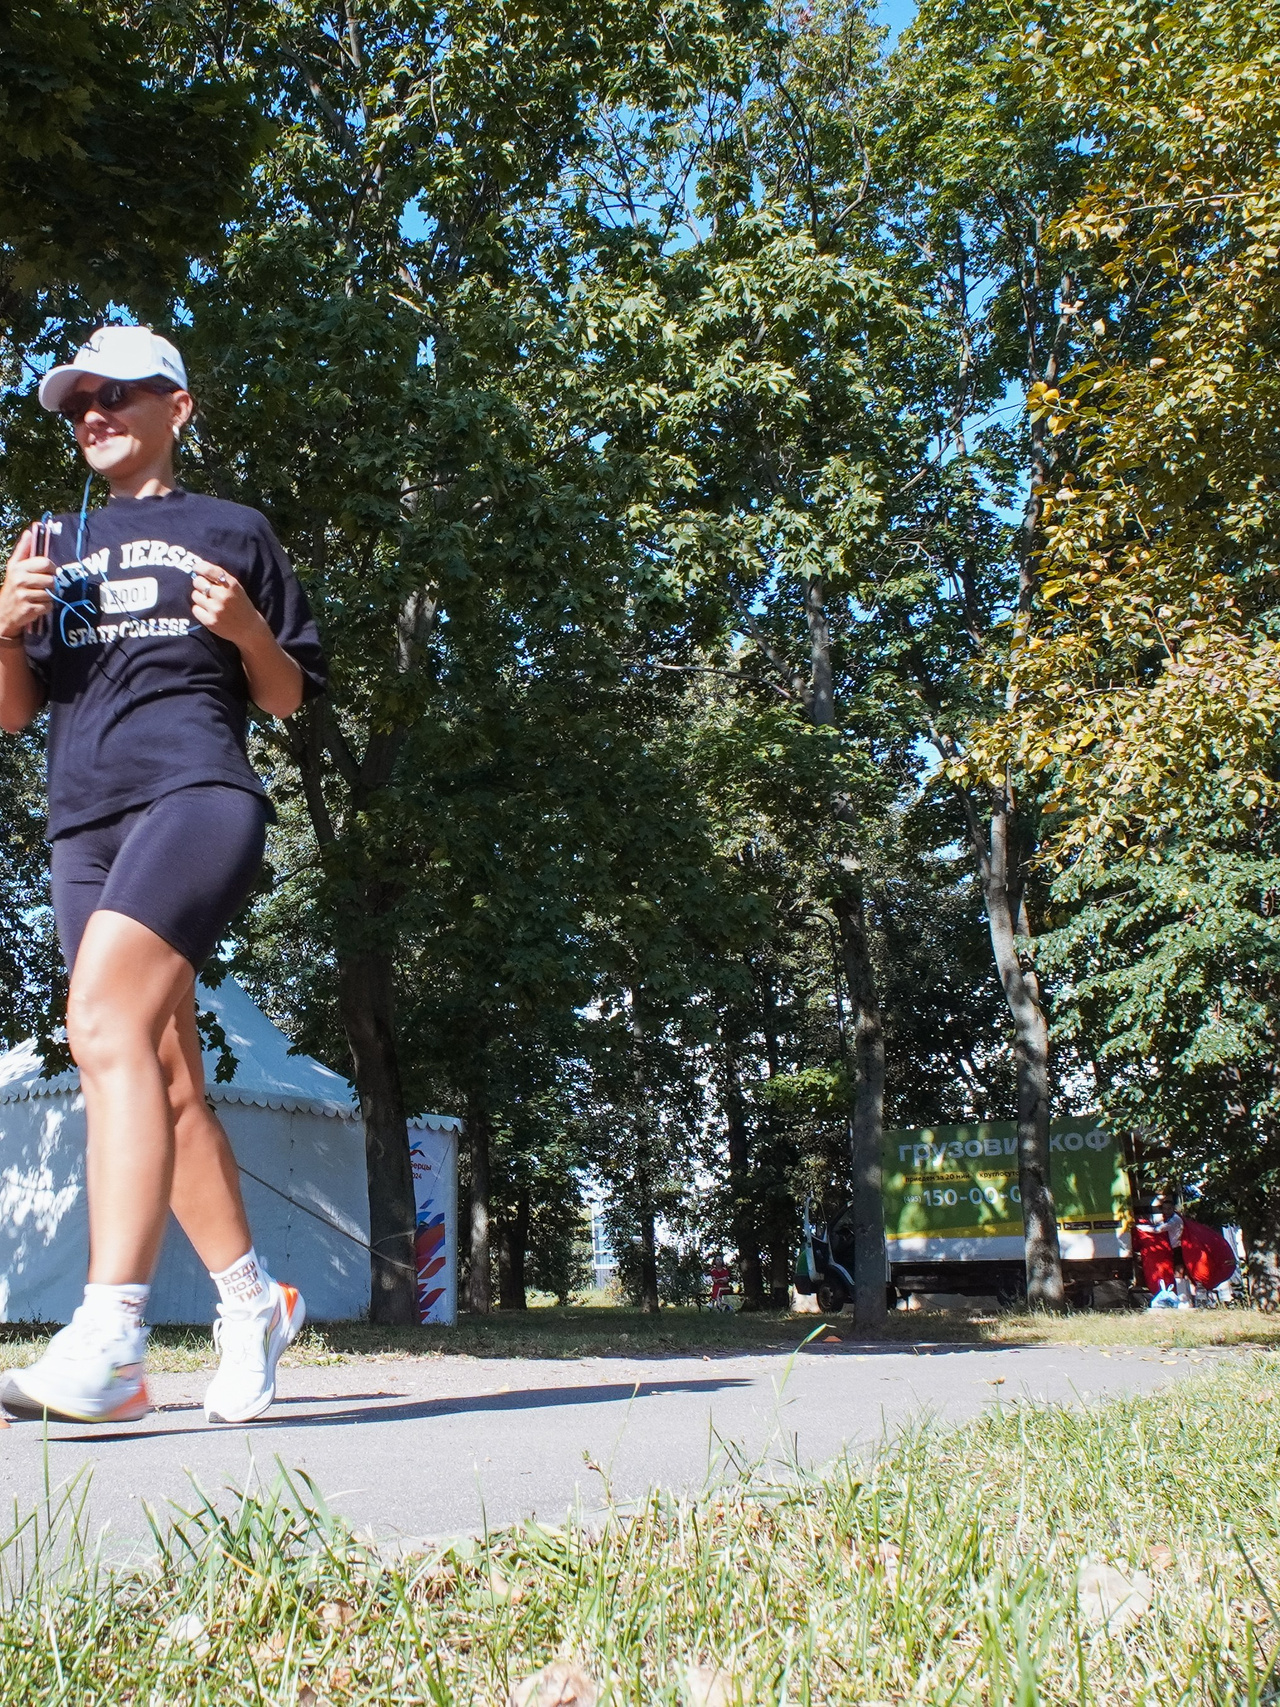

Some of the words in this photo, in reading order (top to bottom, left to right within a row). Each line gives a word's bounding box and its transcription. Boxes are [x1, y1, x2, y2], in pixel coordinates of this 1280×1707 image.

[120, 540, 201, 574] JERSE
[119, 618, 190, 638] COLLEGE
[898, 1127, 1111, 1167] грузовикоф
[410, 1161, 432, 1171] берцы
[946, 1172, 955, 1180] 20
[923, 1185, 1021, 1206] 150-00-0
[222, 1261, 256, 1286] БОДИ
[227, 1270, 258, 1295] ПОЗИ
[235, 1283, 263, 1302] ТИВ
